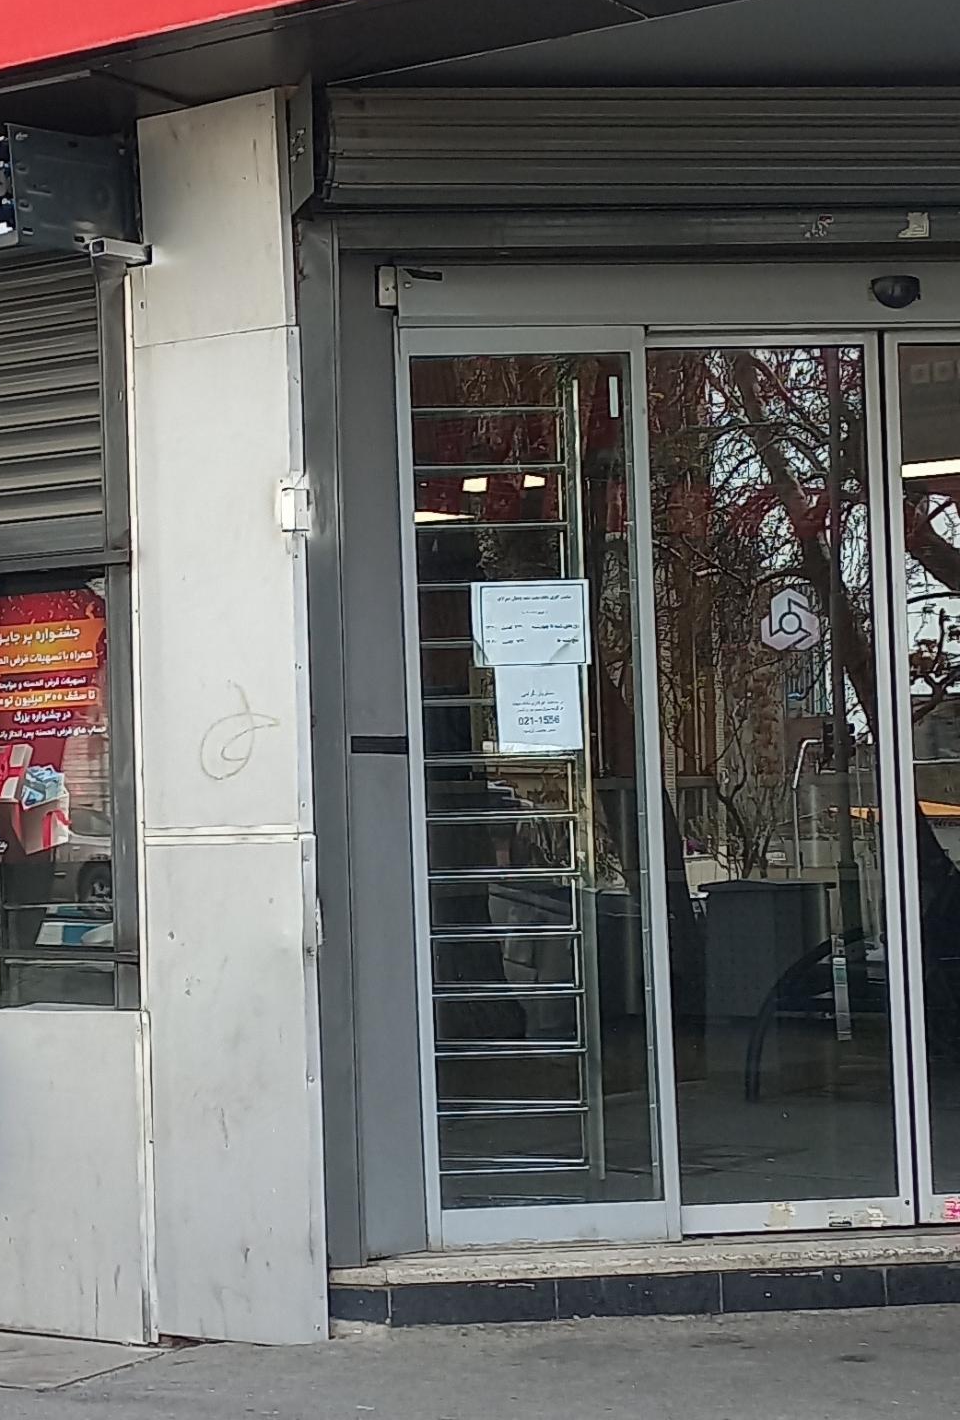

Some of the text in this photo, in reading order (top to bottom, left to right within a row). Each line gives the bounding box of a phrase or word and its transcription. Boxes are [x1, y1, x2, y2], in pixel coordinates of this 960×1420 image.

[35, 625, 81, 643] جشنواره
[10, 654, 29, 667] قرض
[29, 651, 62, 665] تسهیلات
[61, 651, 70, 661] با
[70, 649, 93, 662] همراه
[14, 693, 44, 707] میلیون
[44, 692, 62, 703] ۳۰۰
[63, 690, 87, 702] سقف
[87, 690, 96, 700] تا
